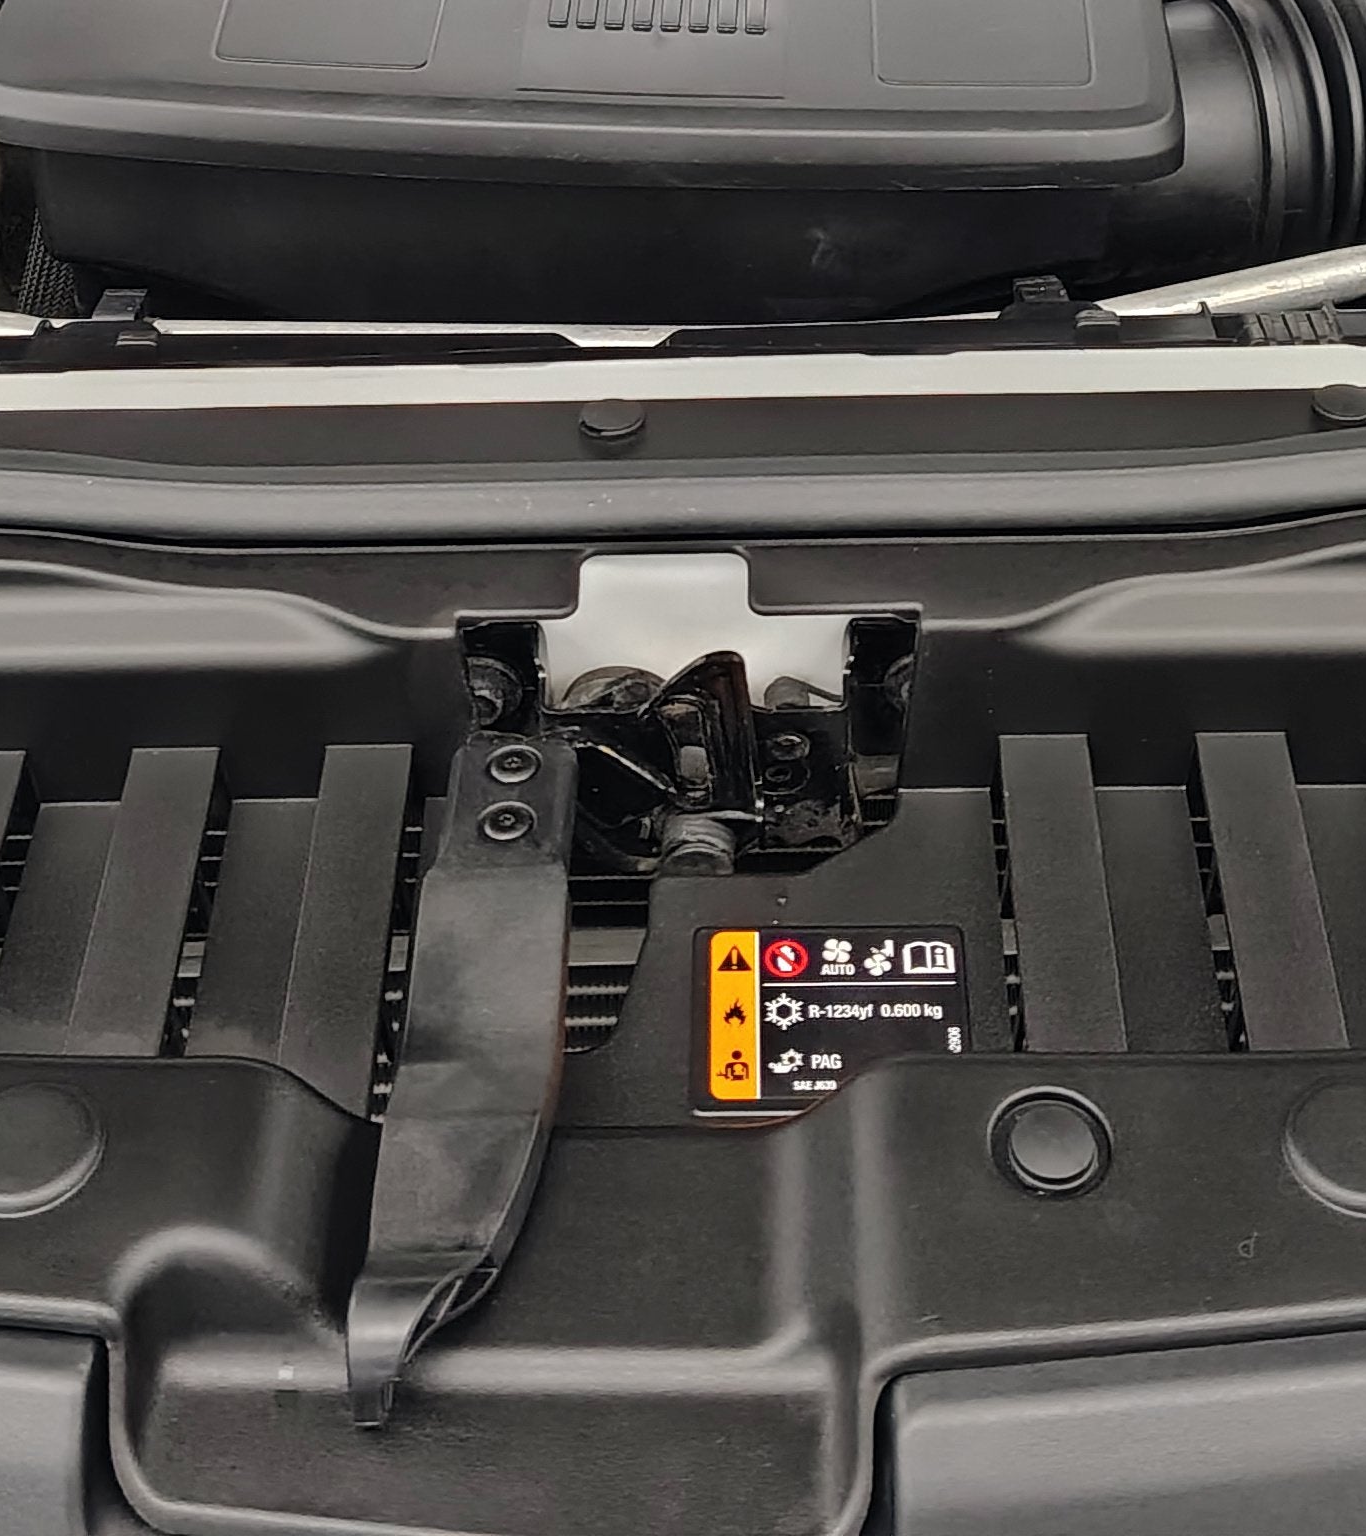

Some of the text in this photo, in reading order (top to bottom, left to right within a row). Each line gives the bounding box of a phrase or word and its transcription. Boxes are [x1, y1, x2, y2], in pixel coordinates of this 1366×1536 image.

[819, 963, 856, 976] AUTO
[807, 1003, 943, 1021] R-1234yf 0.600 kg
[810, 1053, 843, 1070] PAG
[792, 1079, 813, 1091] SAE
